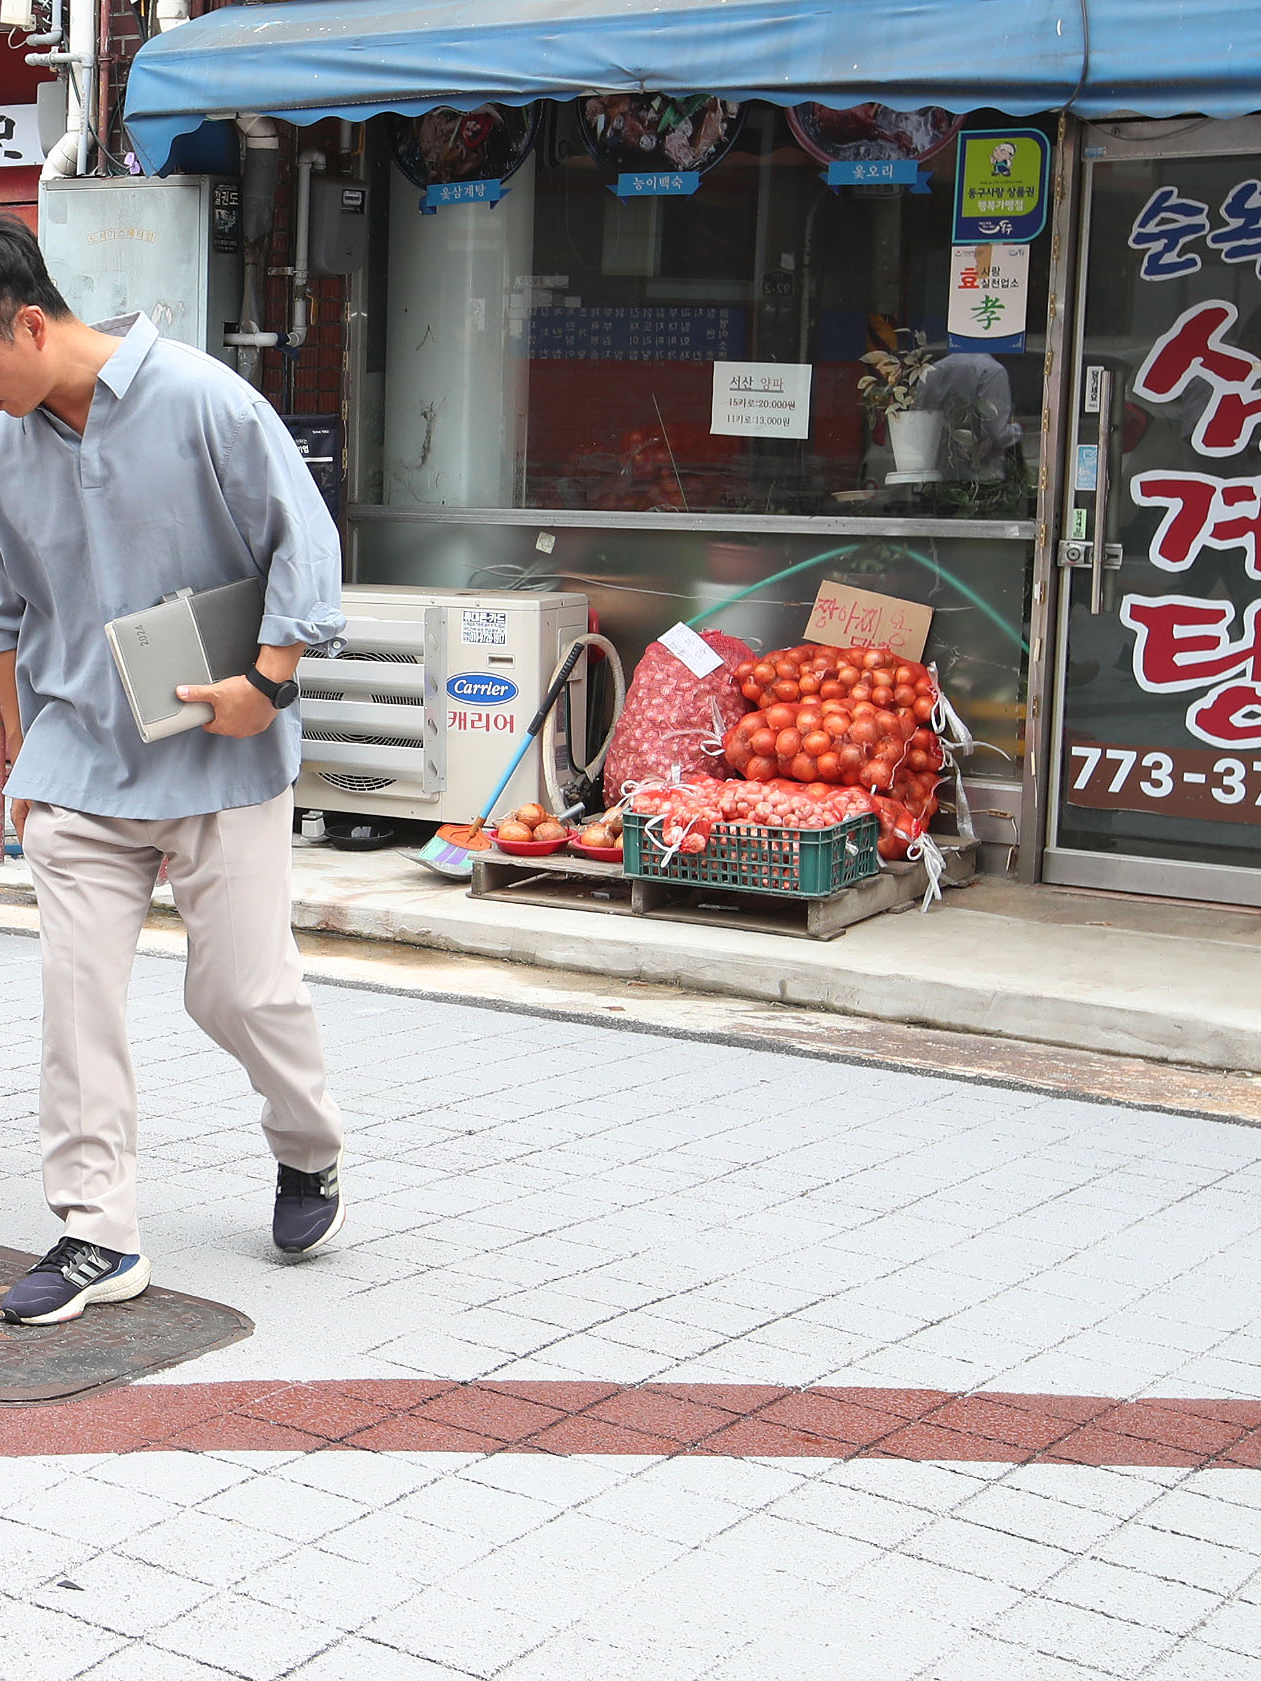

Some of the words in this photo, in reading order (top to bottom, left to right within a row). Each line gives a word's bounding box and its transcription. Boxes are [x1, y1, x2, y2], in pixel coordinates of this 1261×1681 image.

[958, 267, 980, 289] 효
[970, 294, 1005, 330] 孝
[730, 376, 753, 389] 서산
[761, 377, 783, 391] 양파
[454, 679, 509, 696] Carrier
[447, 710, 514, 733] 캐리어
[1071, 746, 1261, 806] 773-3
